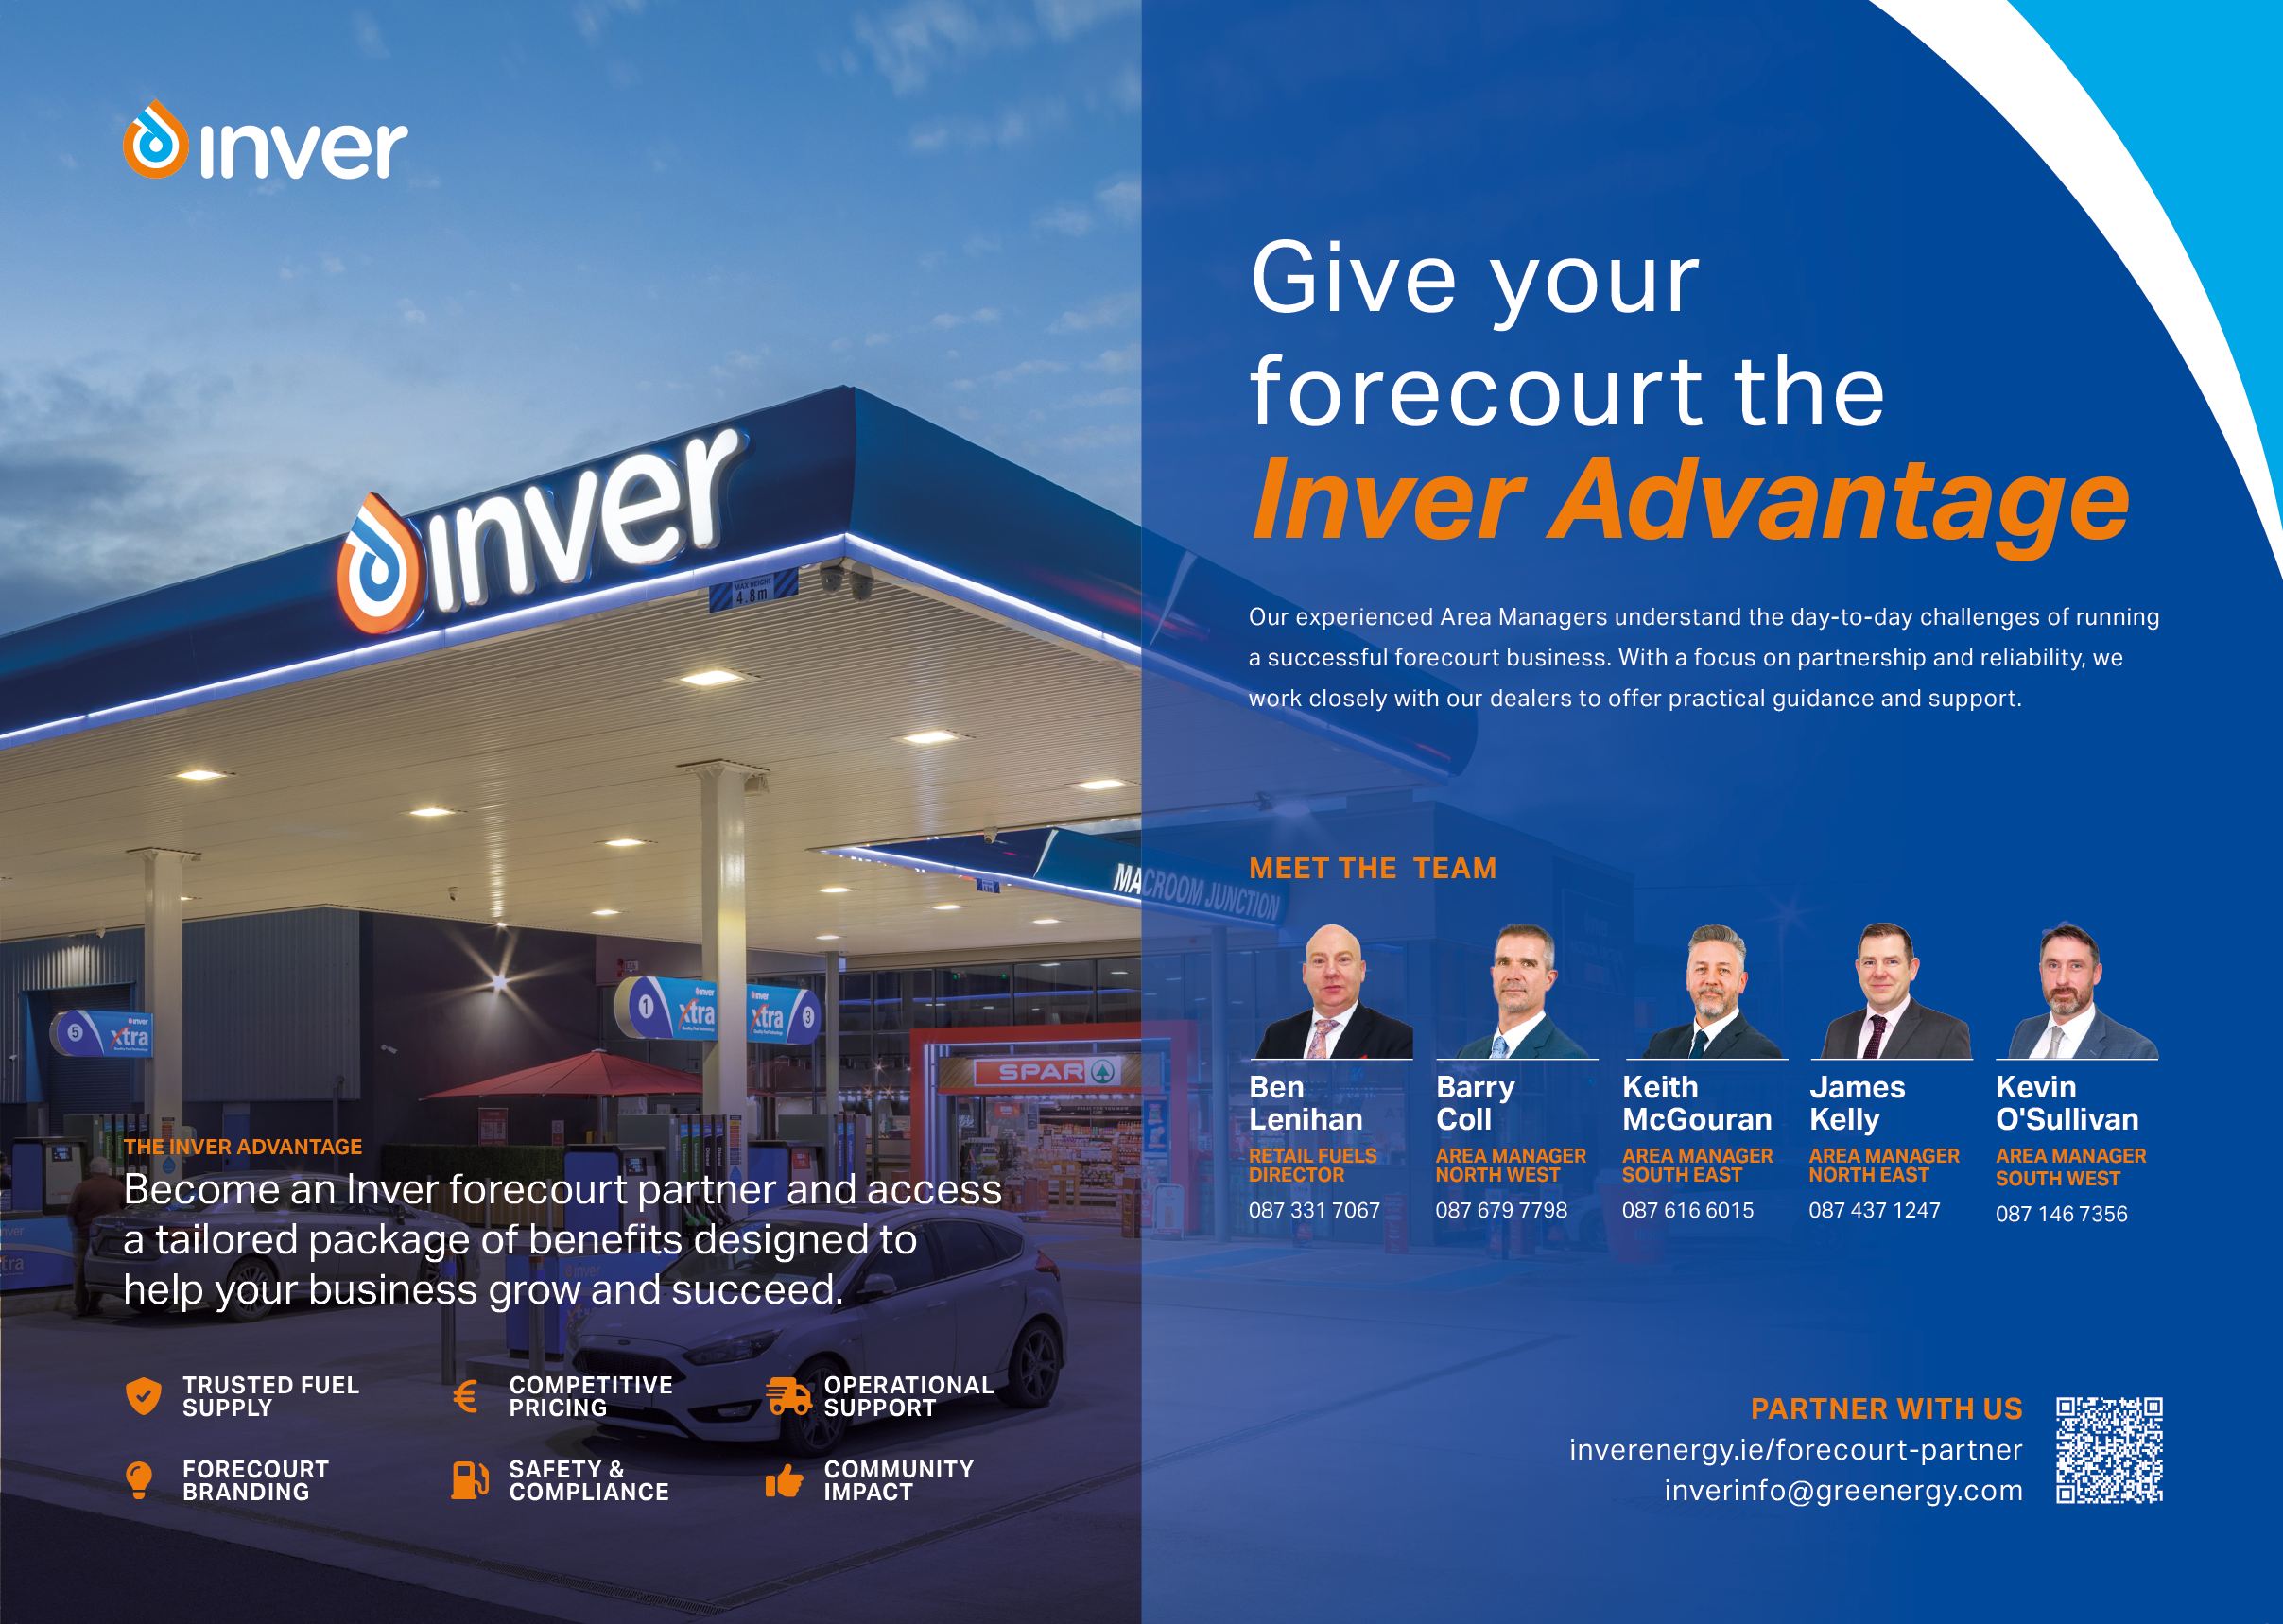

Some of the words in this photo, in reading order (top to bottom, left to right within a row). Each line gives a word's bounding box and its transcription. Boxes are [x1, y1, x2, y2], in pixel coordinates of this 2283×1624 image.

[429, 428, 741, 614] inver
[735, 581, 749, 592] MAX
[750, 578, 771, 588] HEIGHT
[1113, 862, 1205, 907] MACROOM
[1204, 881, 1281, 922] JUNCTION
[755, 992, 770, 1001] inver
[643, 998, 649, 1015] 1
[679, 999, 716, 1026] xtra
[751, 1005, 784, 1029] xtra
[805, 1010, 812, 1025] 3
[72, 1027, 79, 1039] 5
[111, 1027, 149, 1047] xtra
[999, 1063, 1084, 1080] SPAR
[0, 1227, 25, 1237] nver
[573, 1266, 601, 1279] inver
